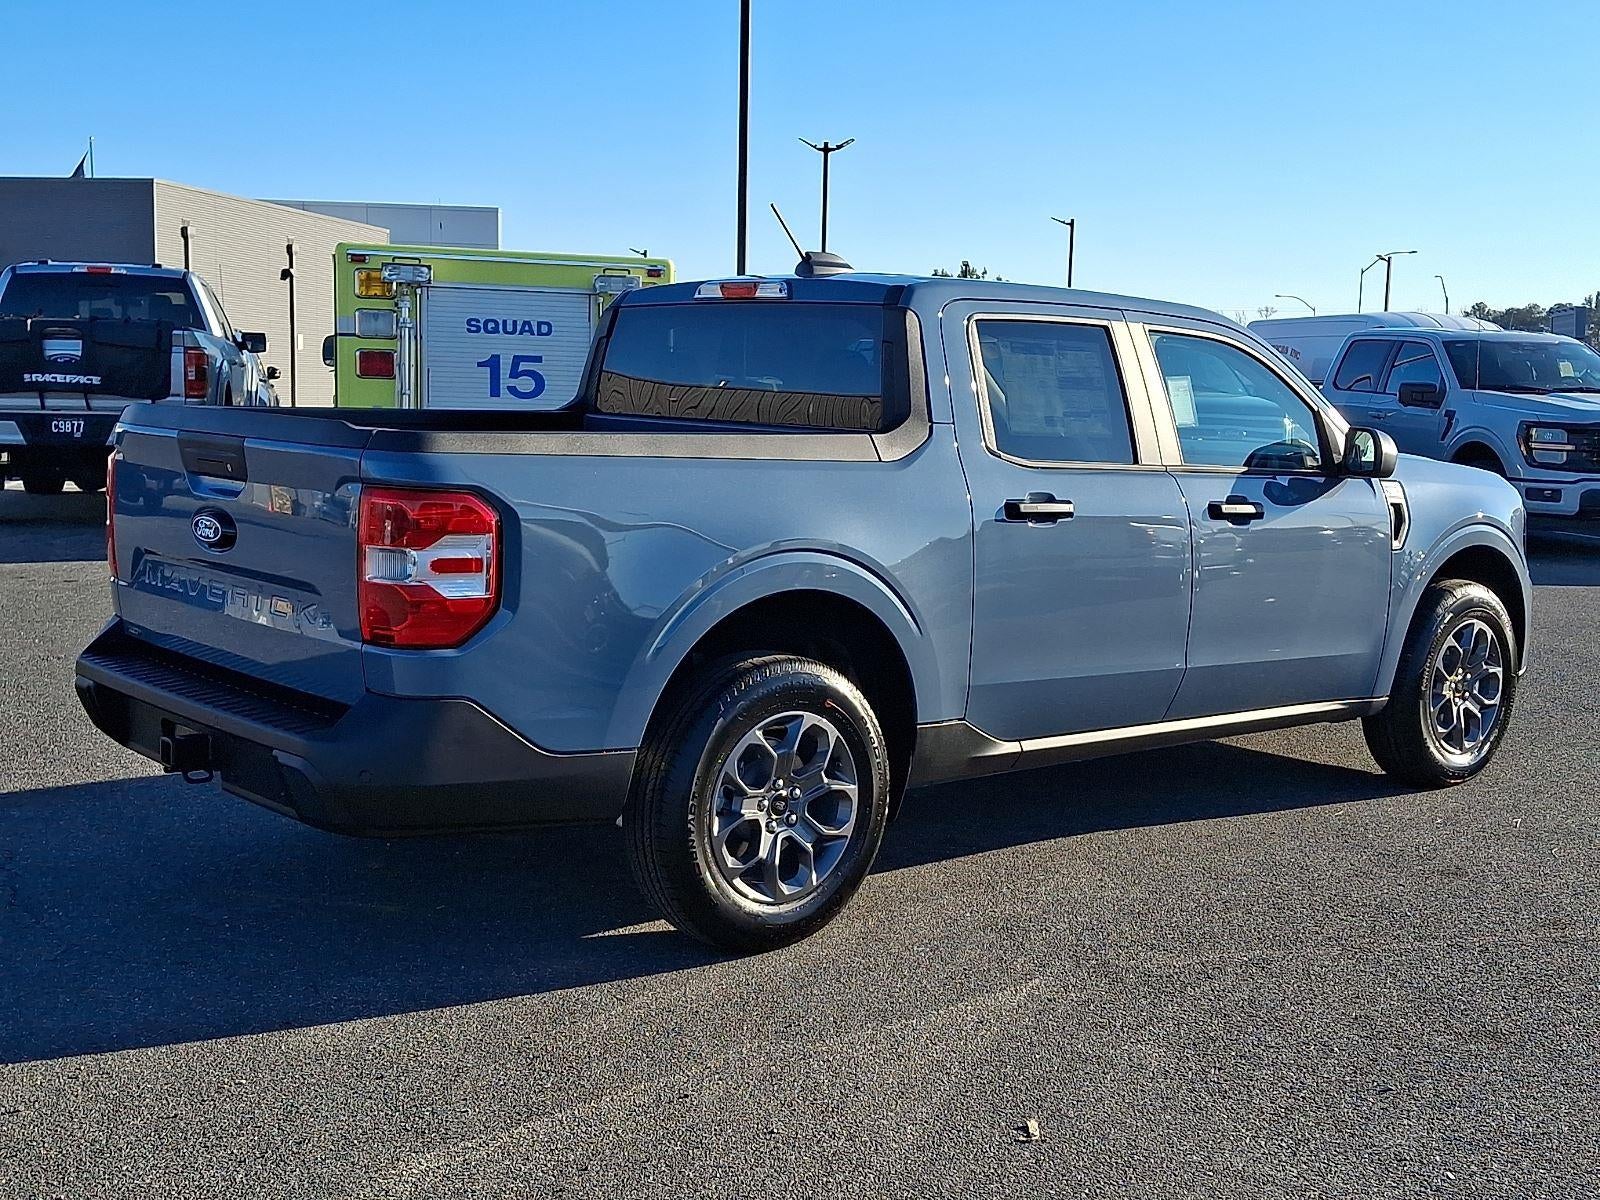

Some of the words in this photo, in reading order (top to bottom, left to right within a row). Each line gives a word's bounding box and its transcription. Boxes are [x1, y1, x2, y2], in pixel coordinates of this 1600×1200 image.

[466, 317, 553, 337] SQUAD
[31, 373, 102, 385] RACEFACE
[476, 353, 546, 400] 15
[52, 420, 85, 433] C9877
[197, 519, 216, 538] Ford
[144, 562, 320, 629] MAVERICK
